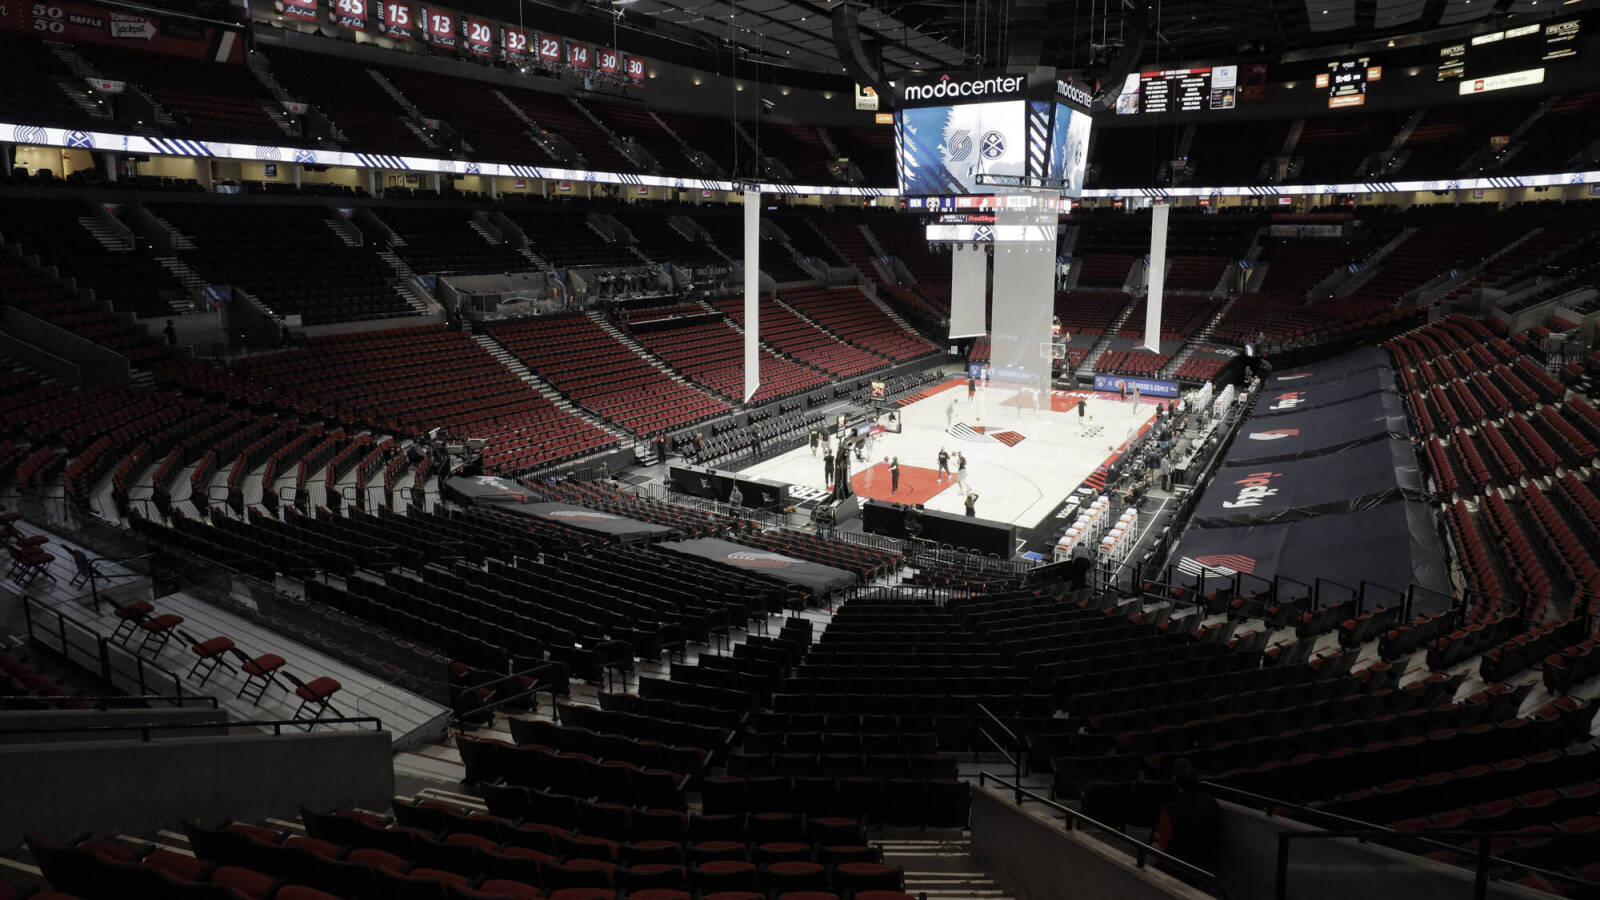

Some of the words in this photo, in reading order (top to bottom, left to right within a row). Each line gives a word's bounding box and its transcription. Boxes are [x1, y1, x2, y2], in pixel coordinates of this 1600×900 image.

[32, 4, 64, 18] 50
[388, 4, 408, 24] 15
[33, 19, 65, 33] 50
[69, 15, 104, 27] RAFFLE
[432, 15, 451, 33] 13
[471, 23, 491, 42] 20
[508, 31, 526, 50] 32
[541, 39, 558, 57] 22
[573, 46, 587, 63] 14
[602, 54, 616, 68] 30
[629, 60, 642, 74] 30
[905, 76, 1024, 100] modacenter
